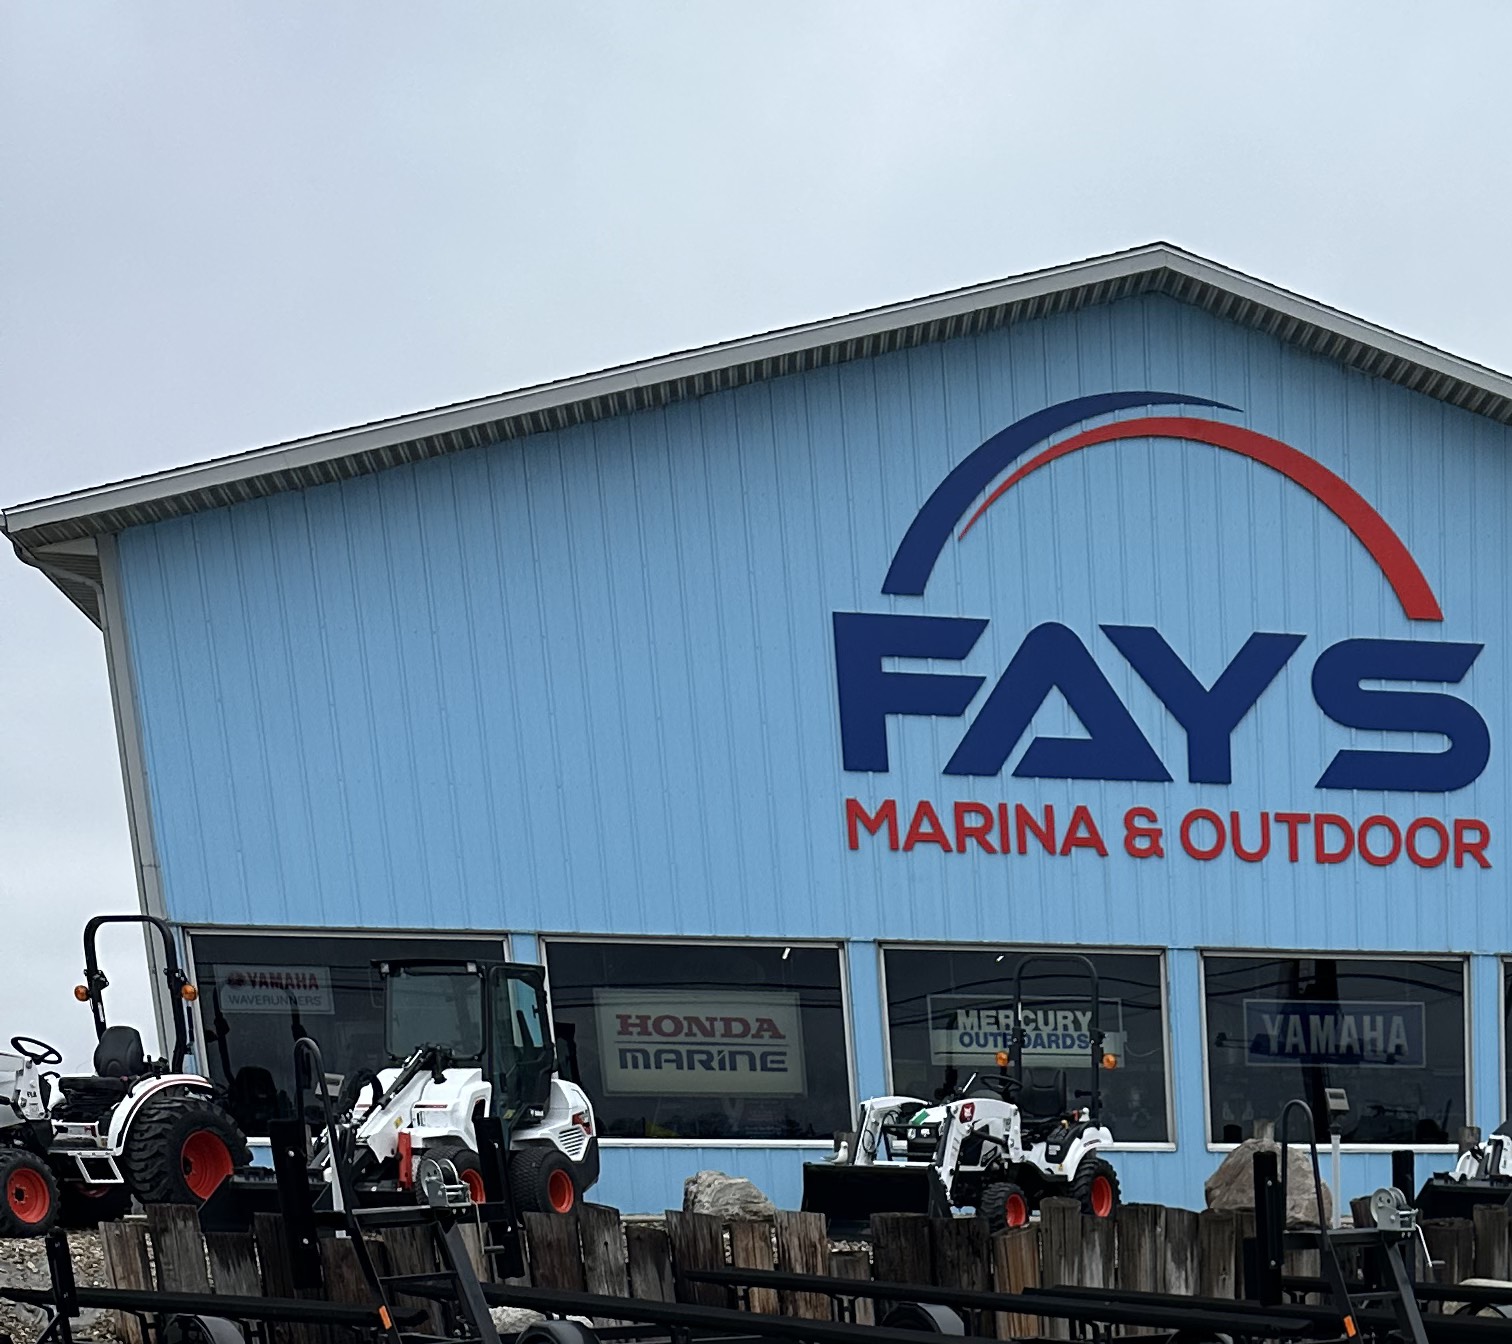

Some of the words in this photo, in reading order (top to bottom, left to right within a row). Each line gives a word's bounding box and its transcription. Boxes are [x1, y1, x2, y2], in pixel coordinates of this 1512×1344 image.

[833, 611, 1491, 793] FAYS
[846, 797, 1108, 857] MARINA
[1123, 806, 1165, 859] &
[1180, 808, 1492, 869] OUTDOOR
[247, 971, 320, 990] YAMAHA
[228, 995, 321, 1006] WAVERUNNERS
[616, 1014, 787, 1040] HONDA
[956, 1009, 1092, 1032] MERCURY
[1262, 1014, 1409, 1056] YAMAHA
[618, 1048, 788, 1072] MARINE
